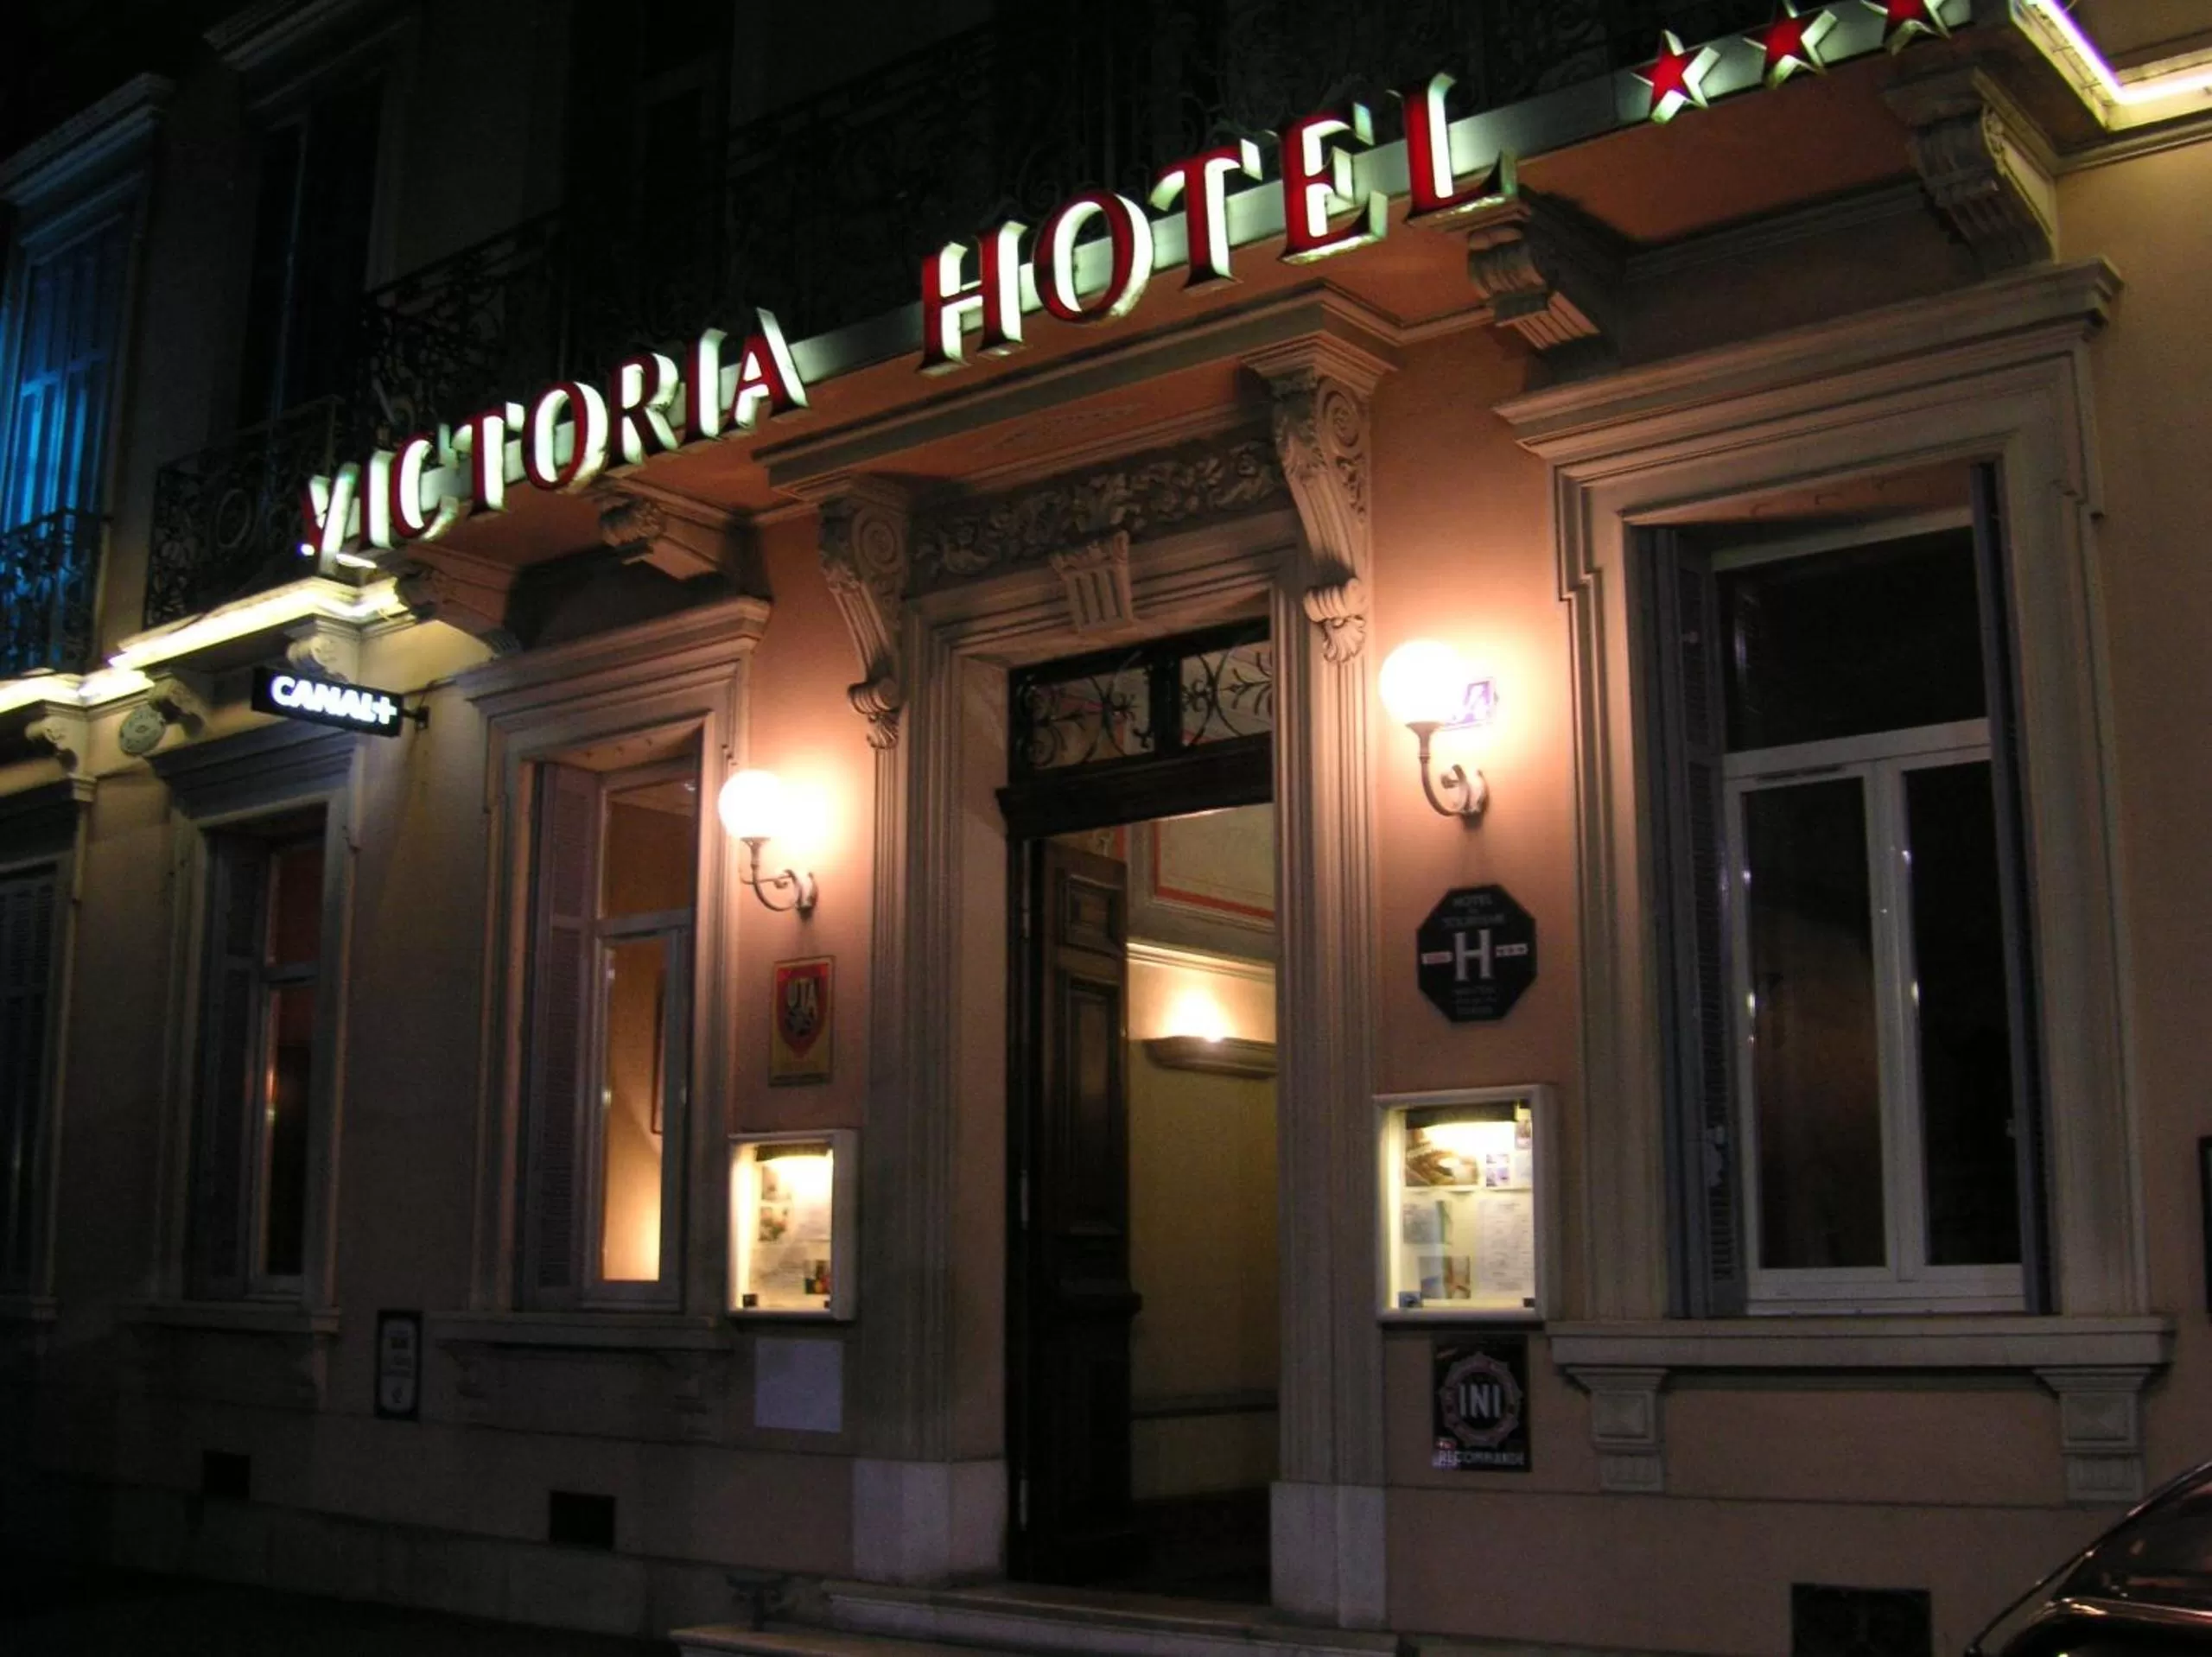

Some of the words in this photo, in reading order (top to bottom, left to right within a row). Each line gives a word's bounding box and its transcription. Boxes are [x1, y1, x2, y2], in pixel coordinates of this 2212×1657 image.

[301, 307, 809, 575] VICTORIA
[917, 72, 1518, 377] HOTEL
[270, 676, 397, 724] CANAL+
[1453, 928, 1495, 982] H
